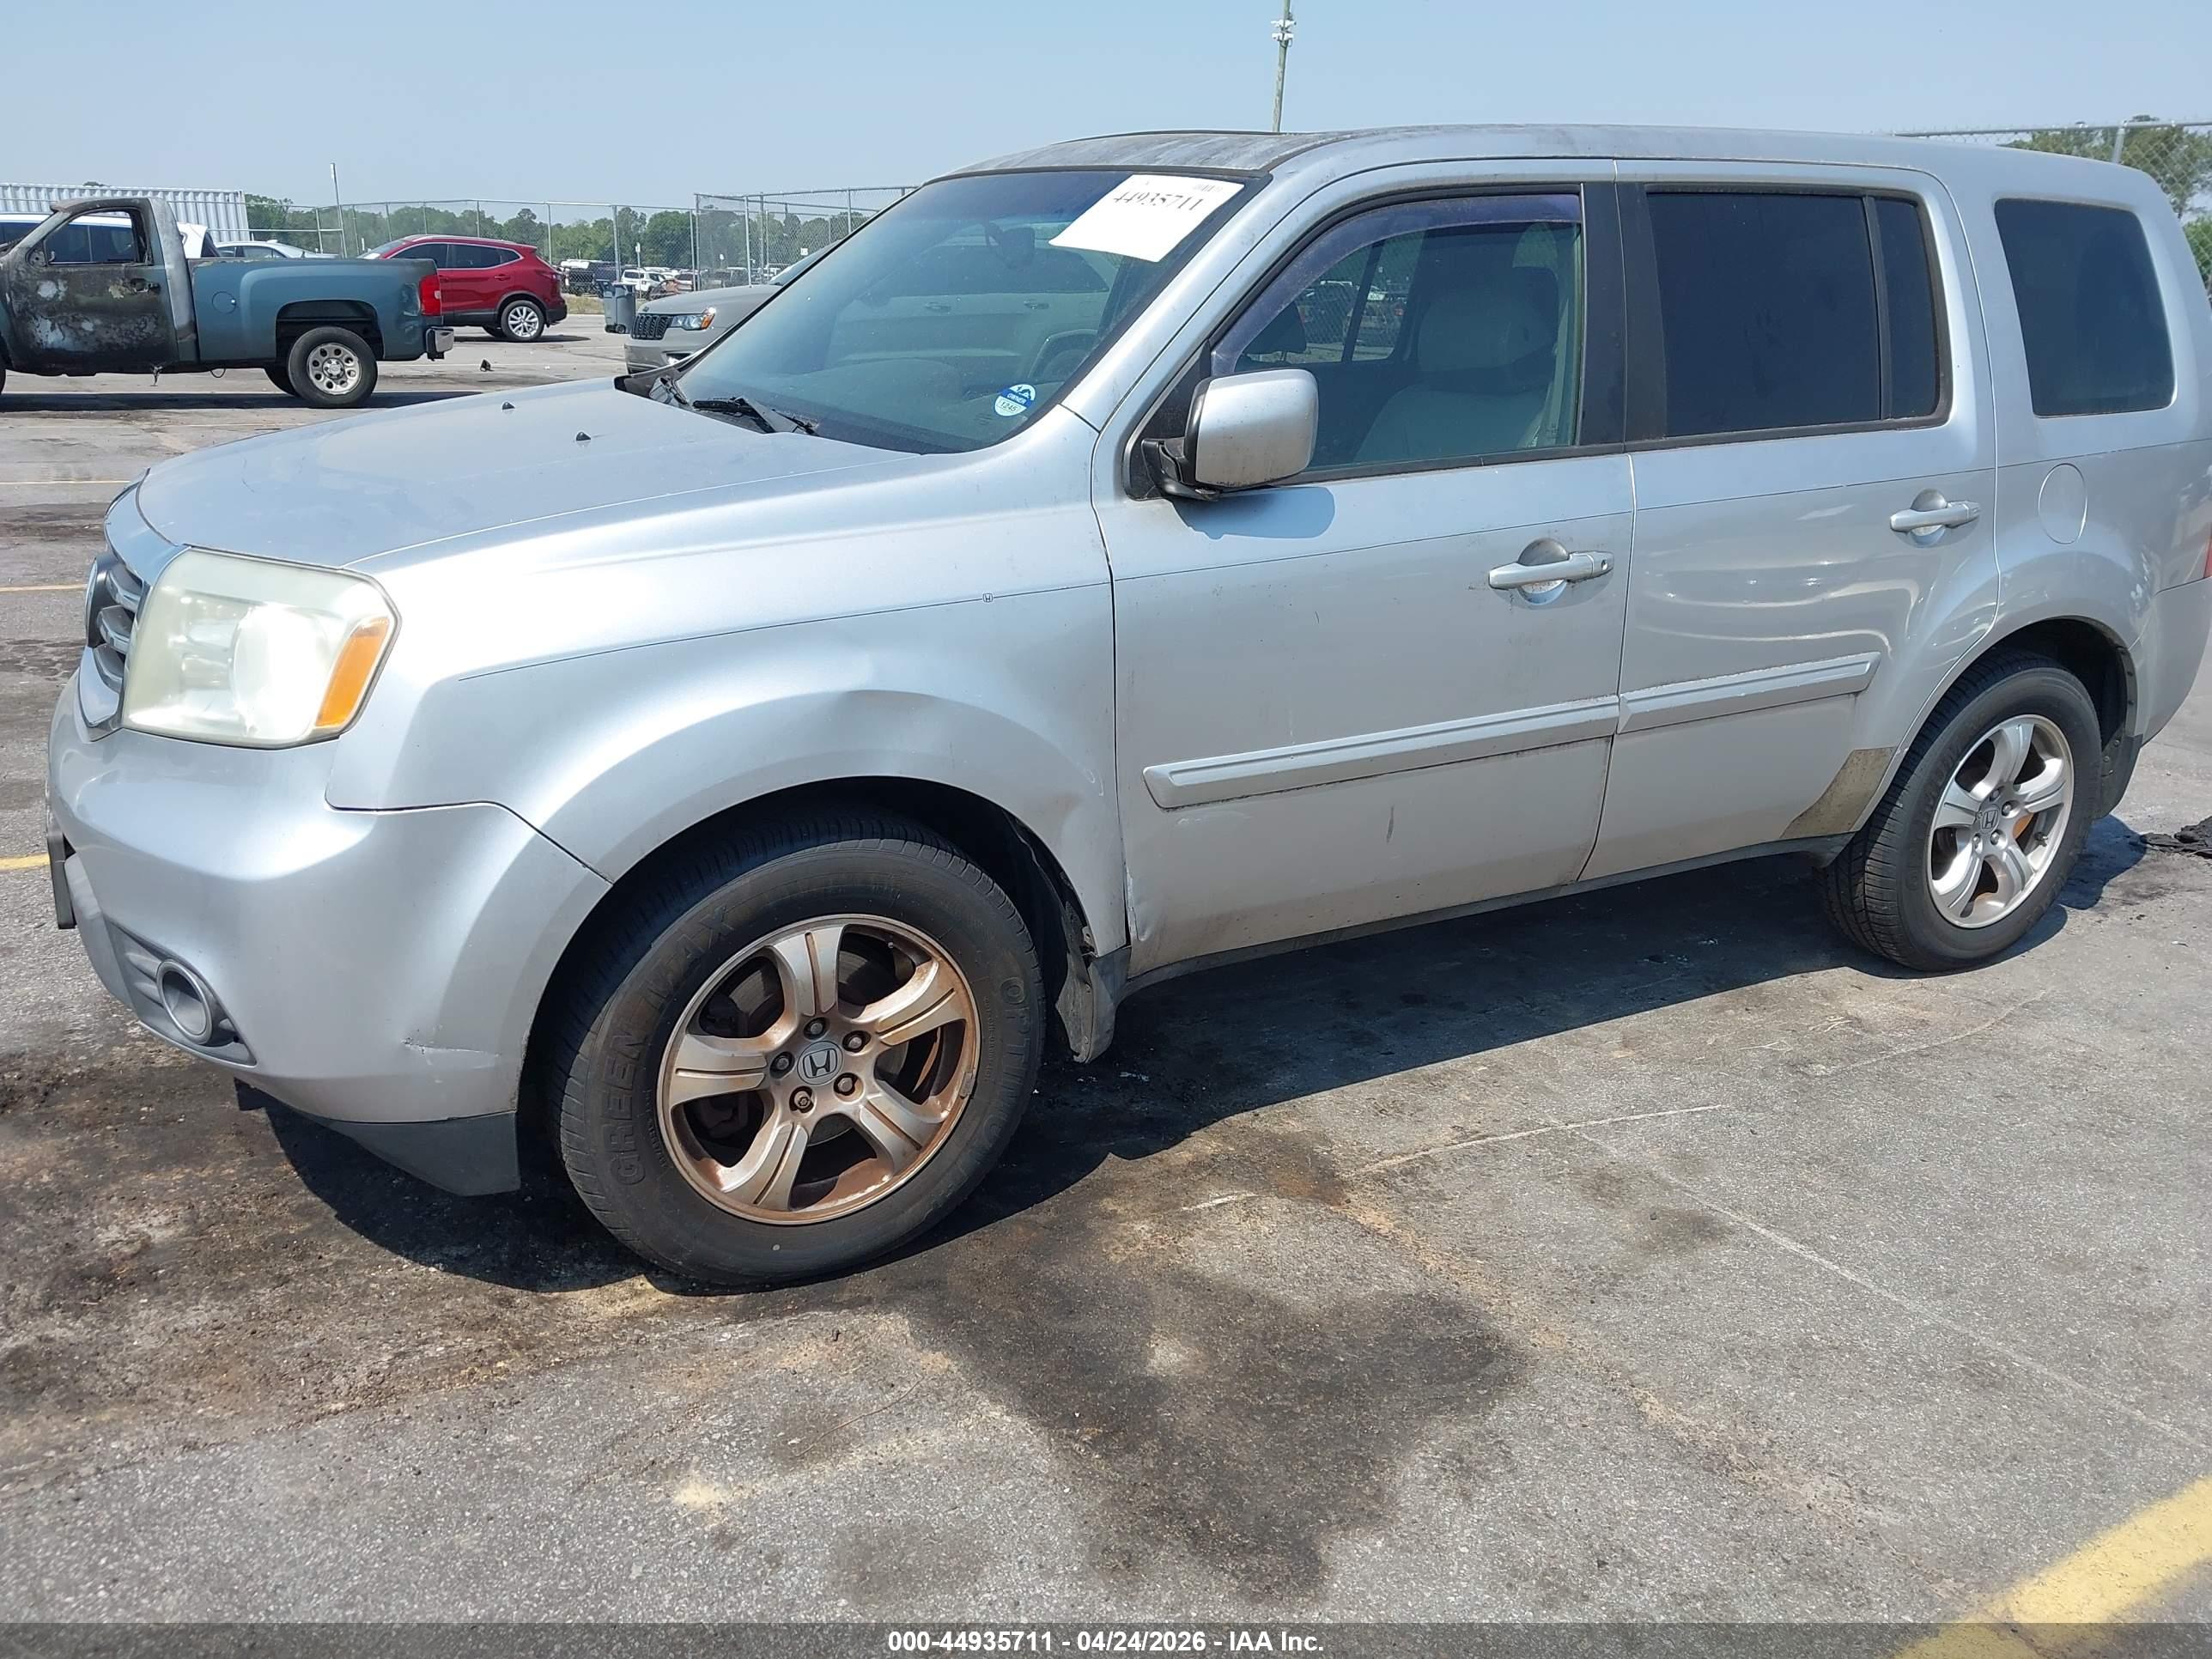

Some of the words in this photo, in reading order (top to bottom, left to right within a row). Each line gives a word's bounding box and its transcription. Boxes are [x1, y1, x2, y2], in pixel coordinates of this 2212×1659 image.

[1114, 191, 1204, 210] 44935711
[1000, 402, 1018, 412] 1245
[603, 1032, 645, 1186] GREEN
